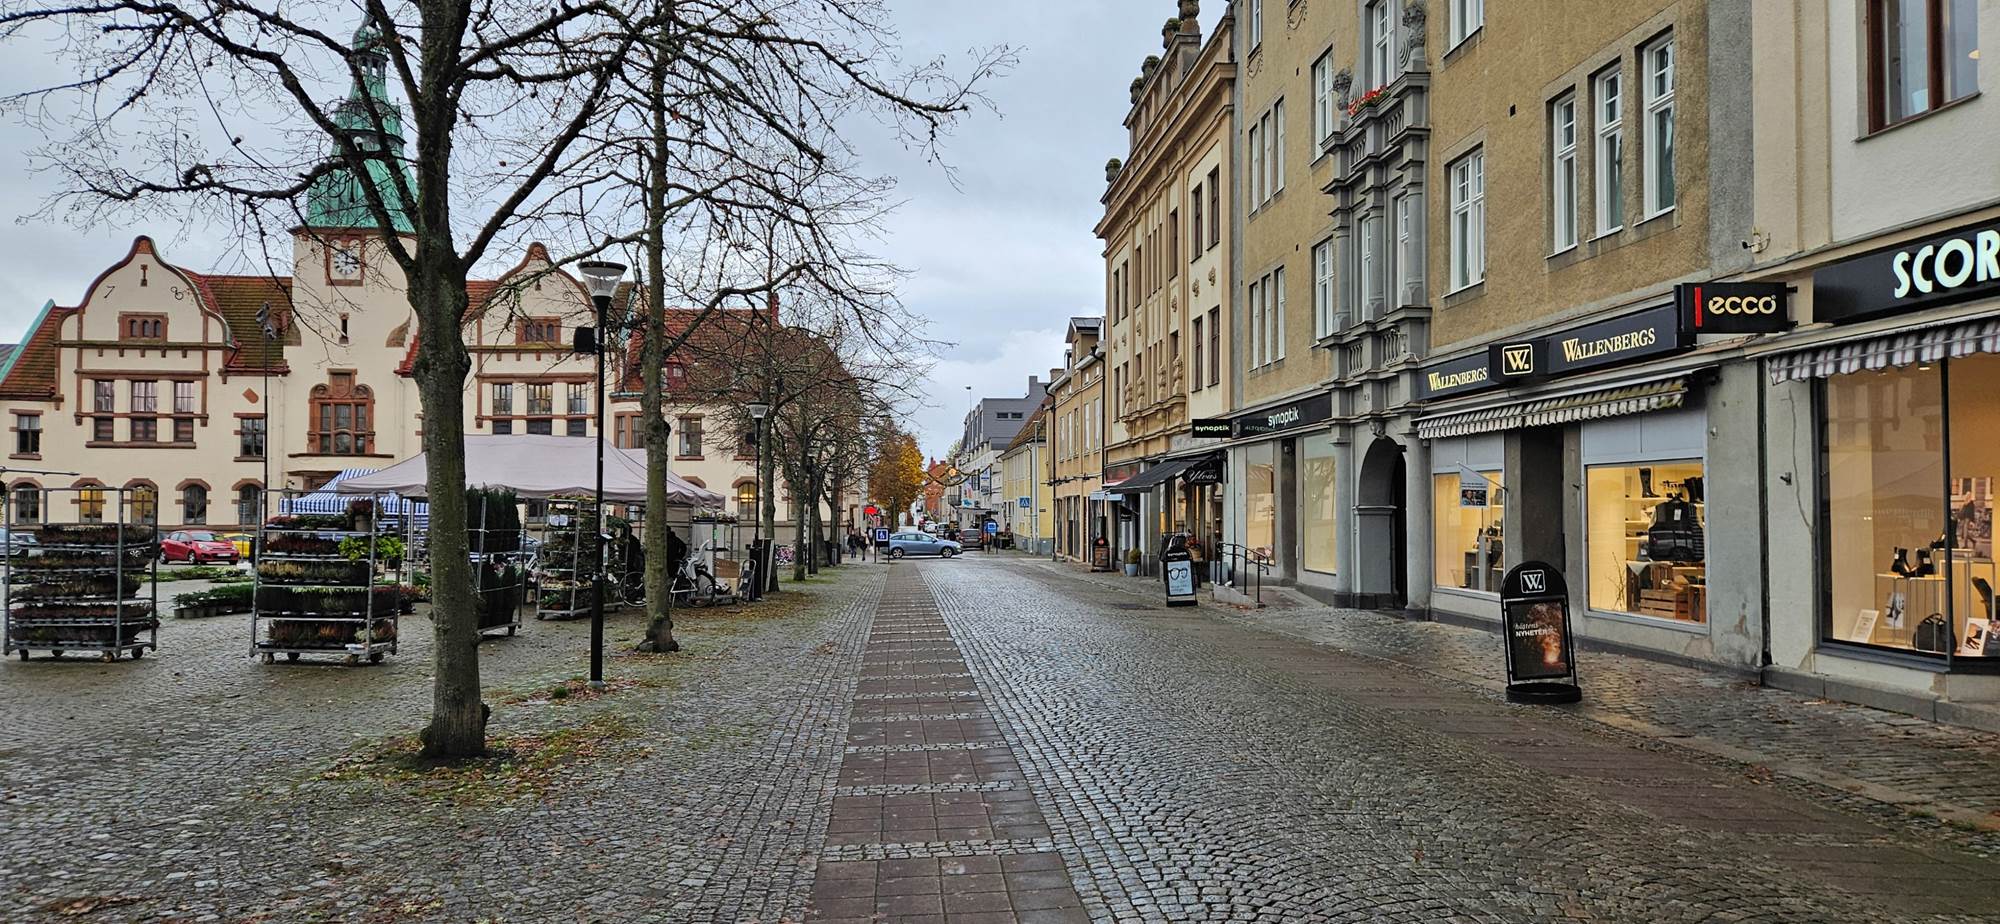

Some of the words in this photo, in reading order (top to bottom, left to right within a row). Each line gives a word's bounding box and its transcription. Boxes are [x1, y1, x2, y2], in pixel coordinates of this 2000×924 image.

[1893, 229, 2000, 299] SCOR
[1708, 296, 1777, 315] ecco
[1562, 328, 1656, 362] WALLENBERGS
[1428, 367, 1488, 391] WALLENBERGS
[1194, 424, 1230, 432] synoptik
[1268, 407, 1299, 428] synoptik
[1515, 628, 1548, 638] NYHETER
